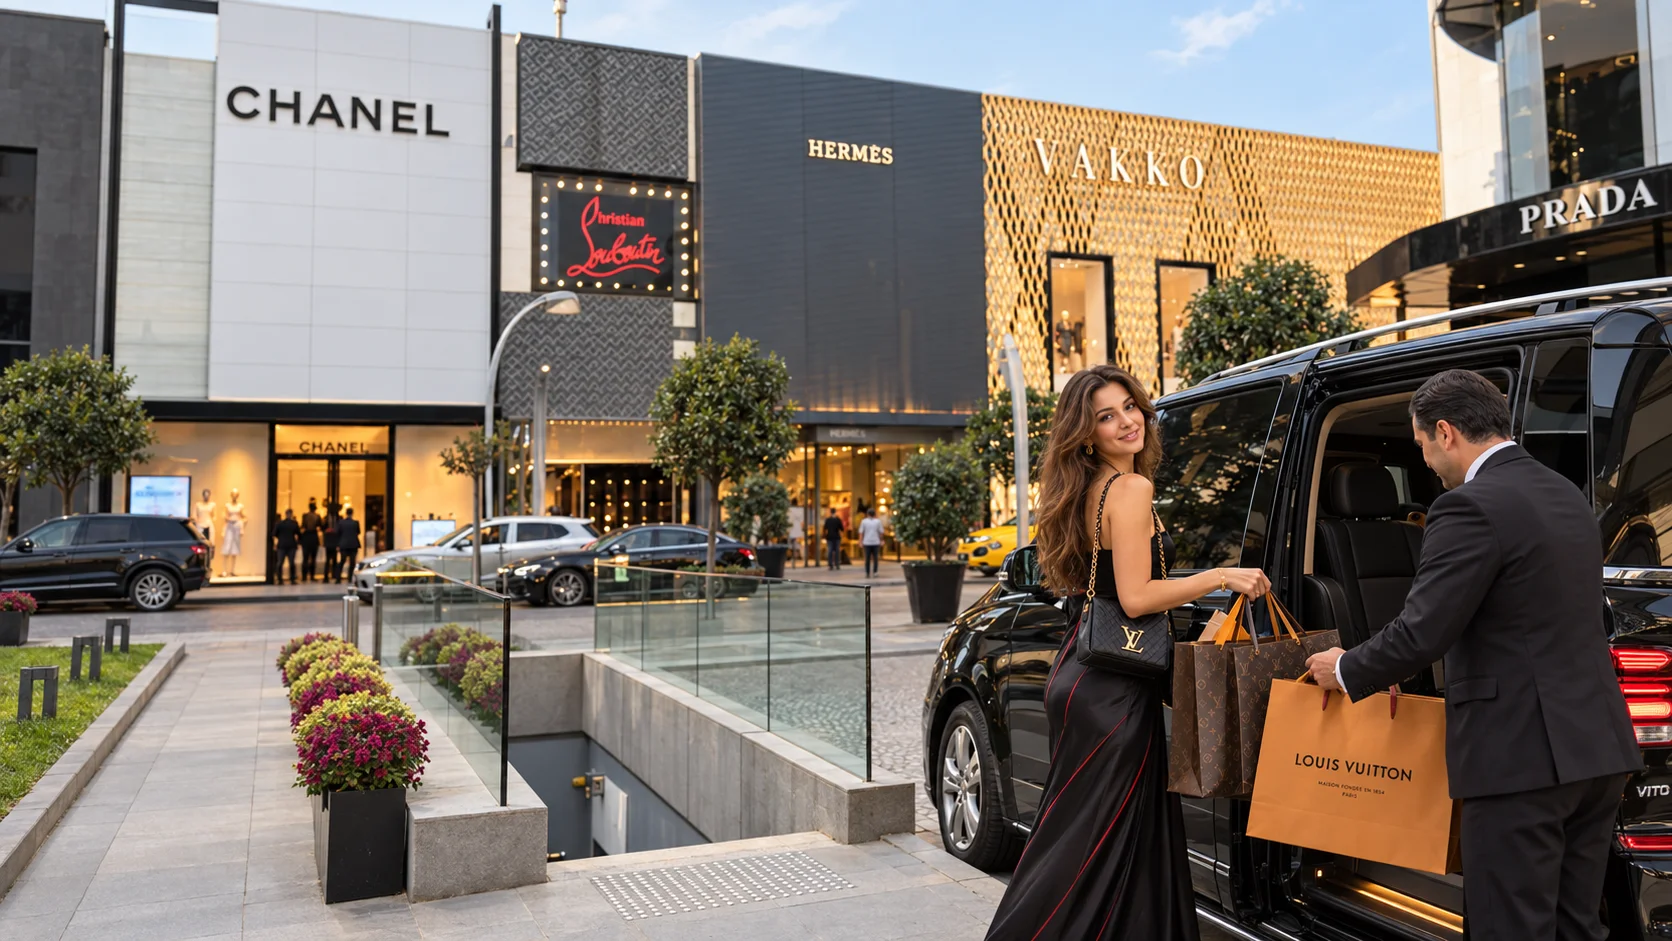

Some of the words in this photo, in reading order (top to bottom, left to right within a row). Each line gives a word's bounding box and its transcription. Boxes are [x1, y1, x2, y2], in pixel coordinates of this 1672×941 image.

[227, 85, 449, 138] CHANEL
[1034, 138, 1204, 189] VAKKO
[581, 196, 645, 227] Christian
[1519, 178, 1658, 234] PRADA
[299, 441, 369, 454] CHANEL
[1295, 753, 1340, 771] LOUIS
[1345, 760, 1412, 782] VUITTON
[1636, 785, 1670, 797] VITO
